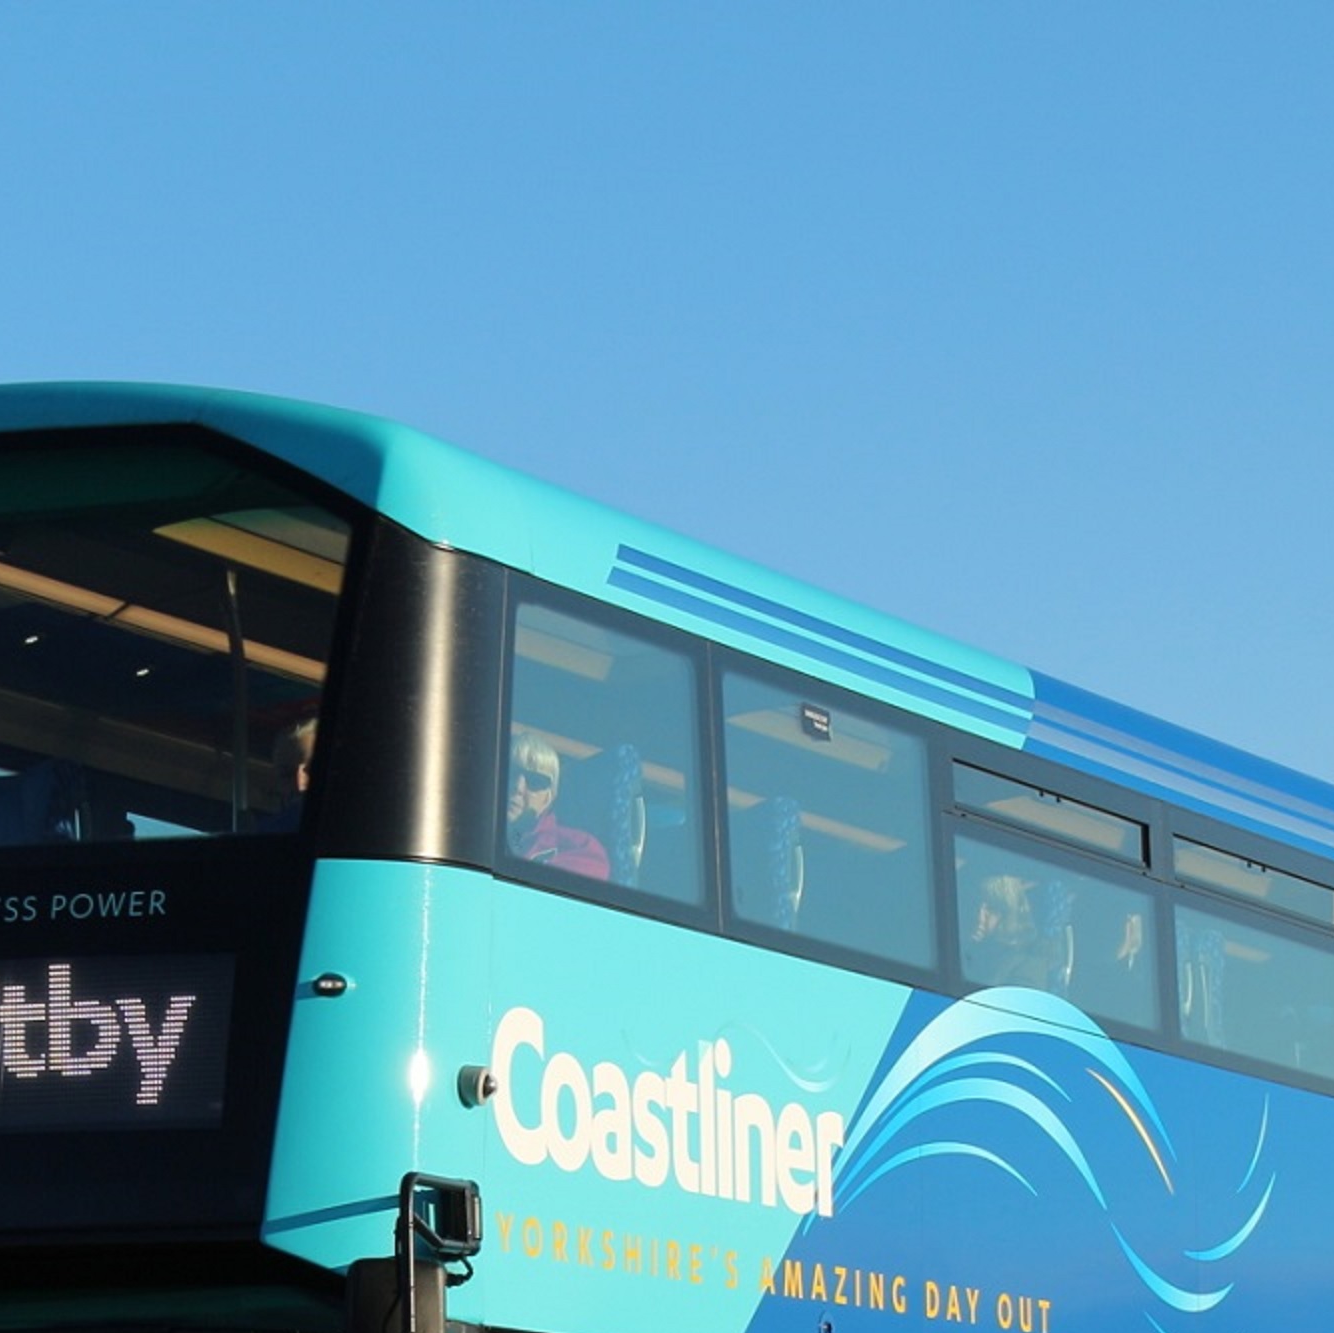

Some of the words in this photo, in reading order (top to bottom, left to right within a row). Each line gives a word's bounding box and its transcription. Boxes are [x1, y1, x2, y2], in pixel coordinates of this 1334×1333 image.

[50, 890, 166, 920] POWER
[490, 1005, 845, 1218] Coastliner
[495, 1211, 739, 1290] YORKSHIRE'S
[760, 1258, 906, 1314] AMAZING
[925, 1279, 980, 1325] DAY
